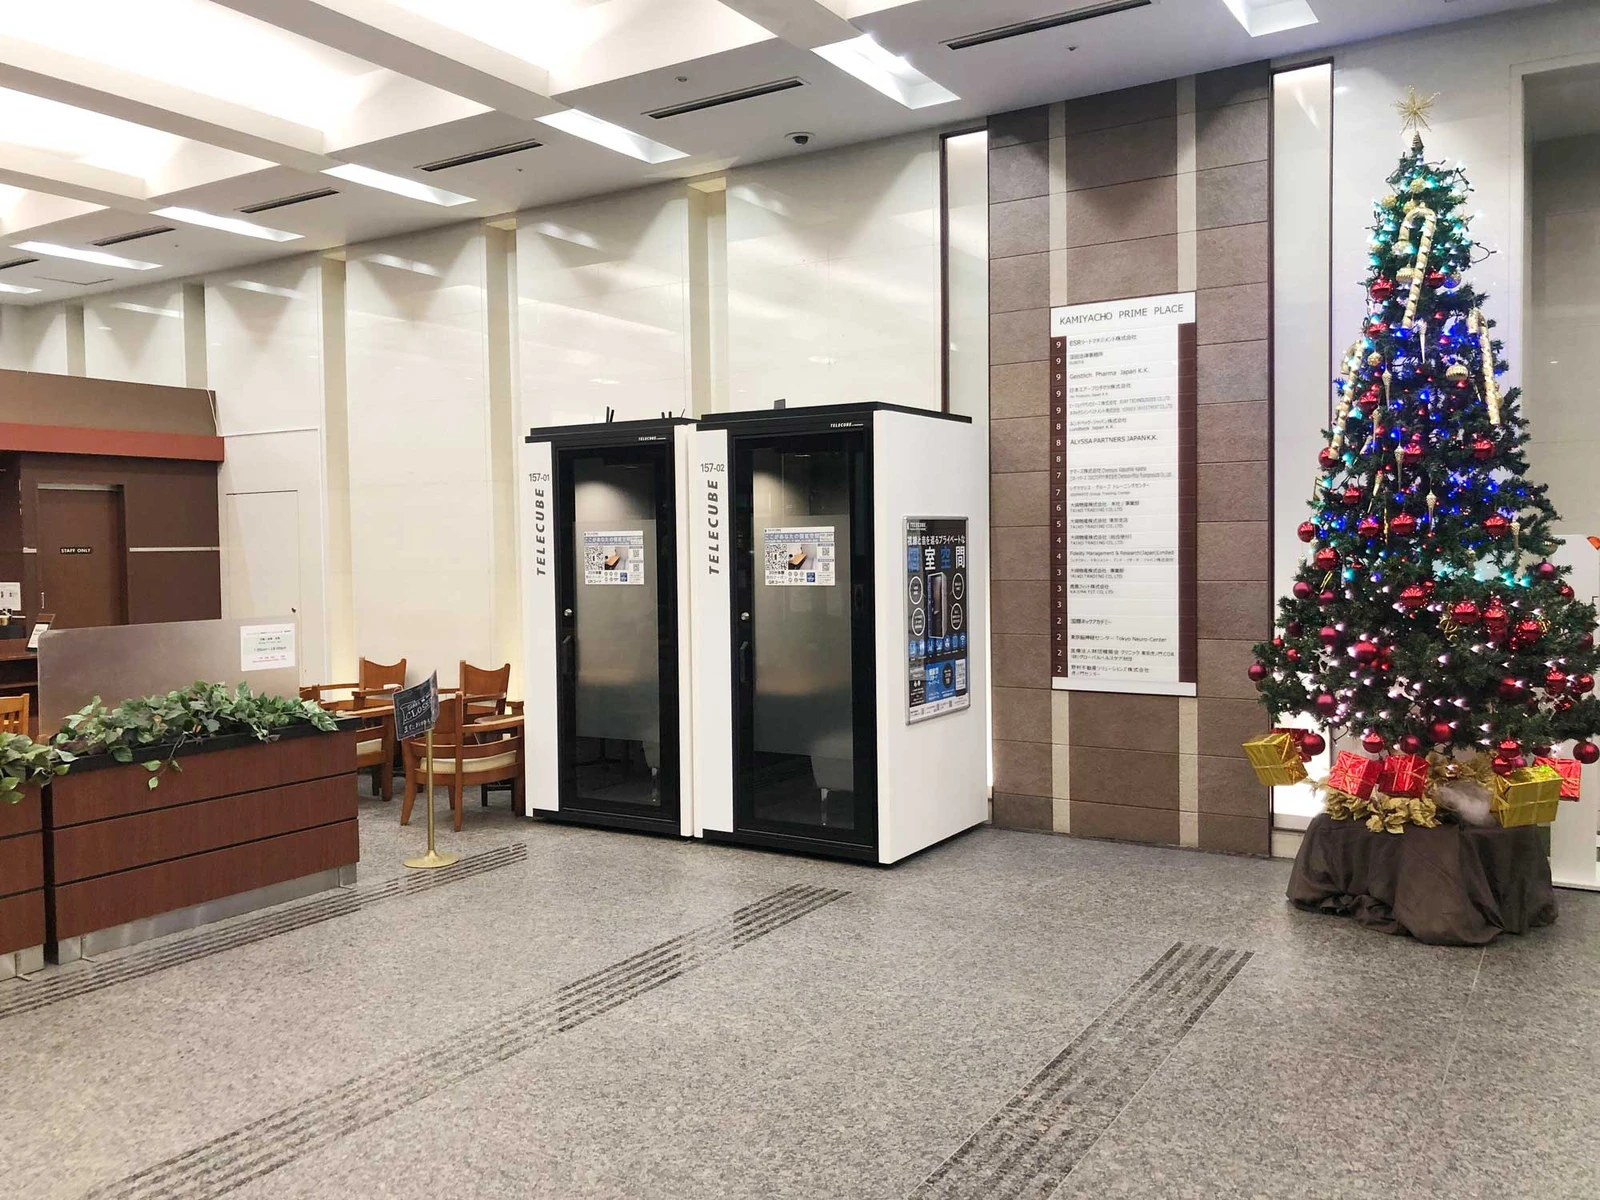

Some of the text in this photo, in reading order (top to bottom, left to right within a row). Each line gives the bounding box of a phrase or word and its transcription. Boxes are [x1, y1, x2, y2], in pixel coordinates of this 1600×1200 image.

[1060, 304, 1183, 325] KAMIYACHO PRIME PLACE
[529, 473, 550, 482] 157-01
[701, 463, 724, 473] 157-02
[535, 488, 546, 576] TELECUBE
[708, 480, 719, 575] TELECUBE
[908, 546, 965, 571] 個室空間
